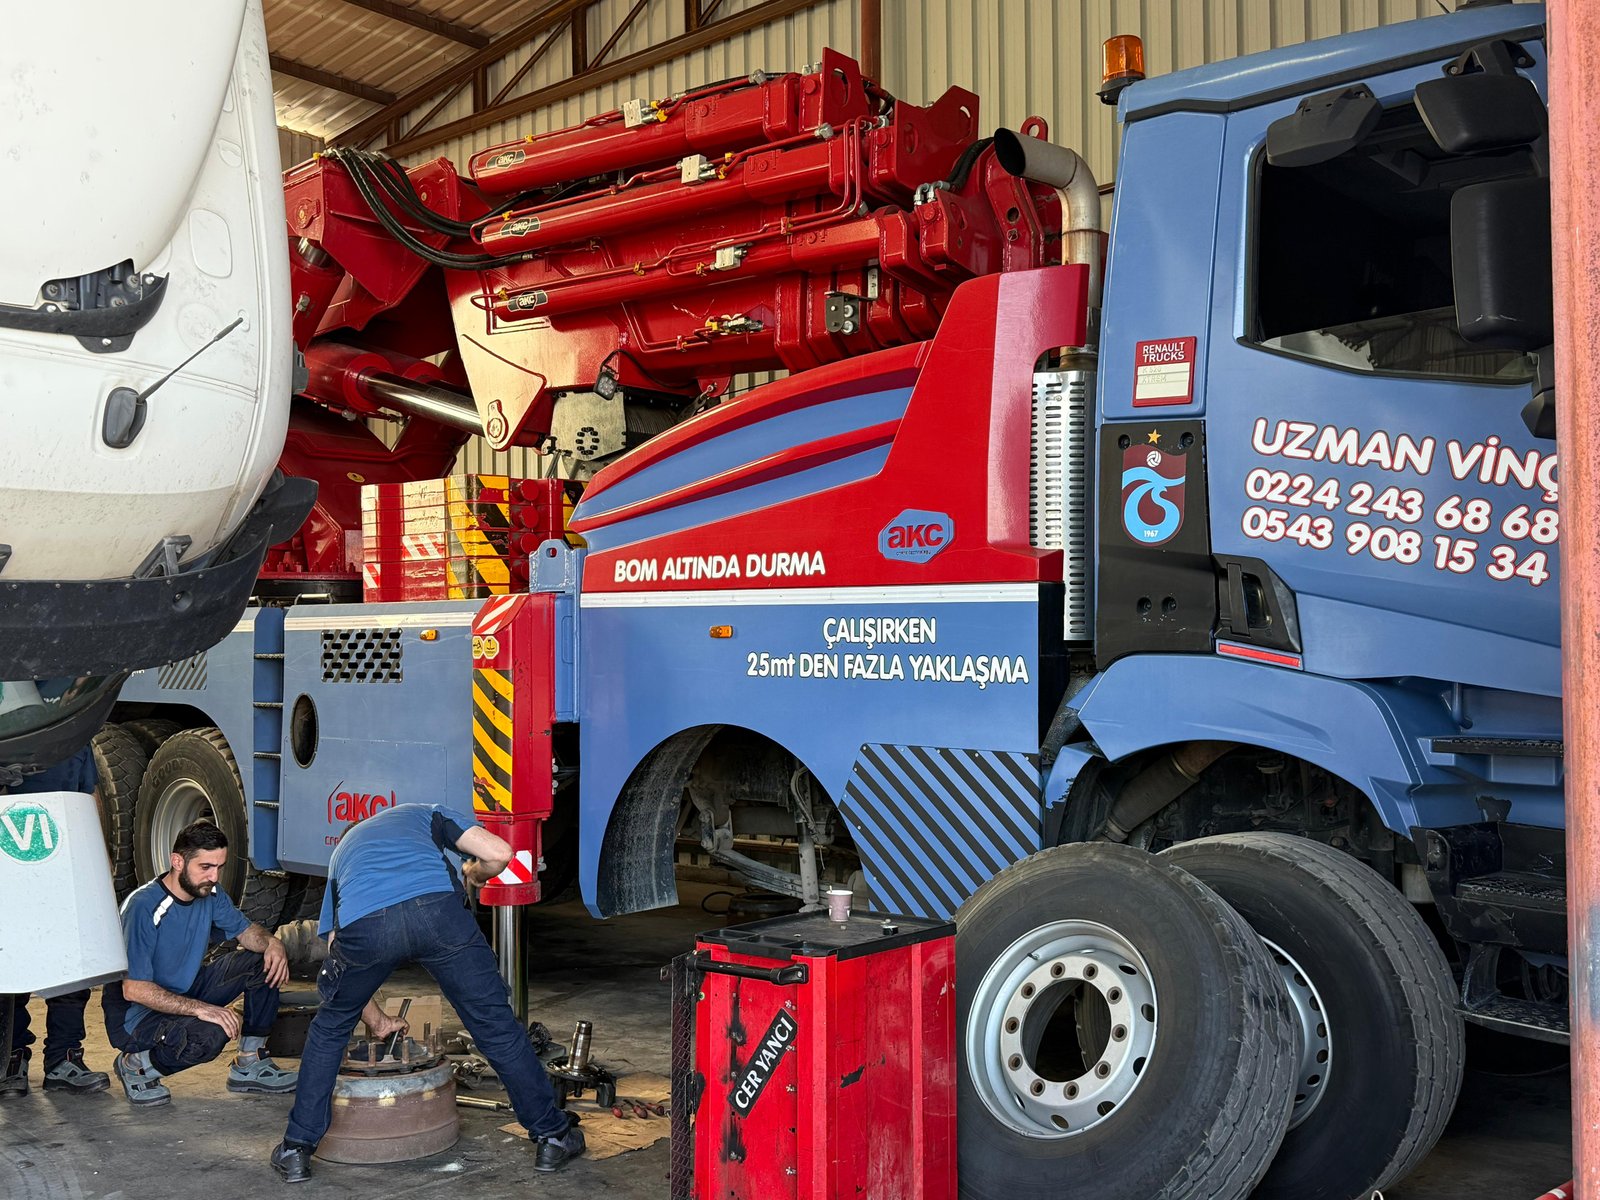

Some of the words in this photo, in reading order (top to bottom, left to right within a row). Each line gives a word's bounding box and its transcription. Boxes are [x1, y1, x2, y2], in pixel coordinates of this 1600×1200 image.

[1143, 342, 1185, 354] RENAULT
[1143, 351, 1184, 363] TRUCKS
[1252, 417, 1436, 475] UZMAN
[1245, 468, 1340, 510] 0224
[1345, 481, 1424, 523] 243
[1434, 495, 1492, 534] 68
[1501, 505, 1560, 545] 68
[1144, 530, 1158, 538] 1967
[1241, 506, 1334, 549] 0543
[1345, 522, 1423, 564] 908
[1434, 534, 1478, 573] 15
[1486, 545, 1550, 586] 34
[614, 558, 658, 583] BOM
[661, 554, 741, 580] ALTINDA
[745, 550, 826, 578] DURMA
[823, 617, 937, 650] ÇALIŞIRKEN
[746, 652, 795, 678] 25mt
[799, 653, 839, 680] DEN
[843, 654, 904, 681] FAZLA
[909, 655, 1030, 690] YAKLAŞMA
[0, 813, 53, 851] VI
[736, 1070, 763, 1109] CER
[755, 1017, 793, 1072] YANCI
